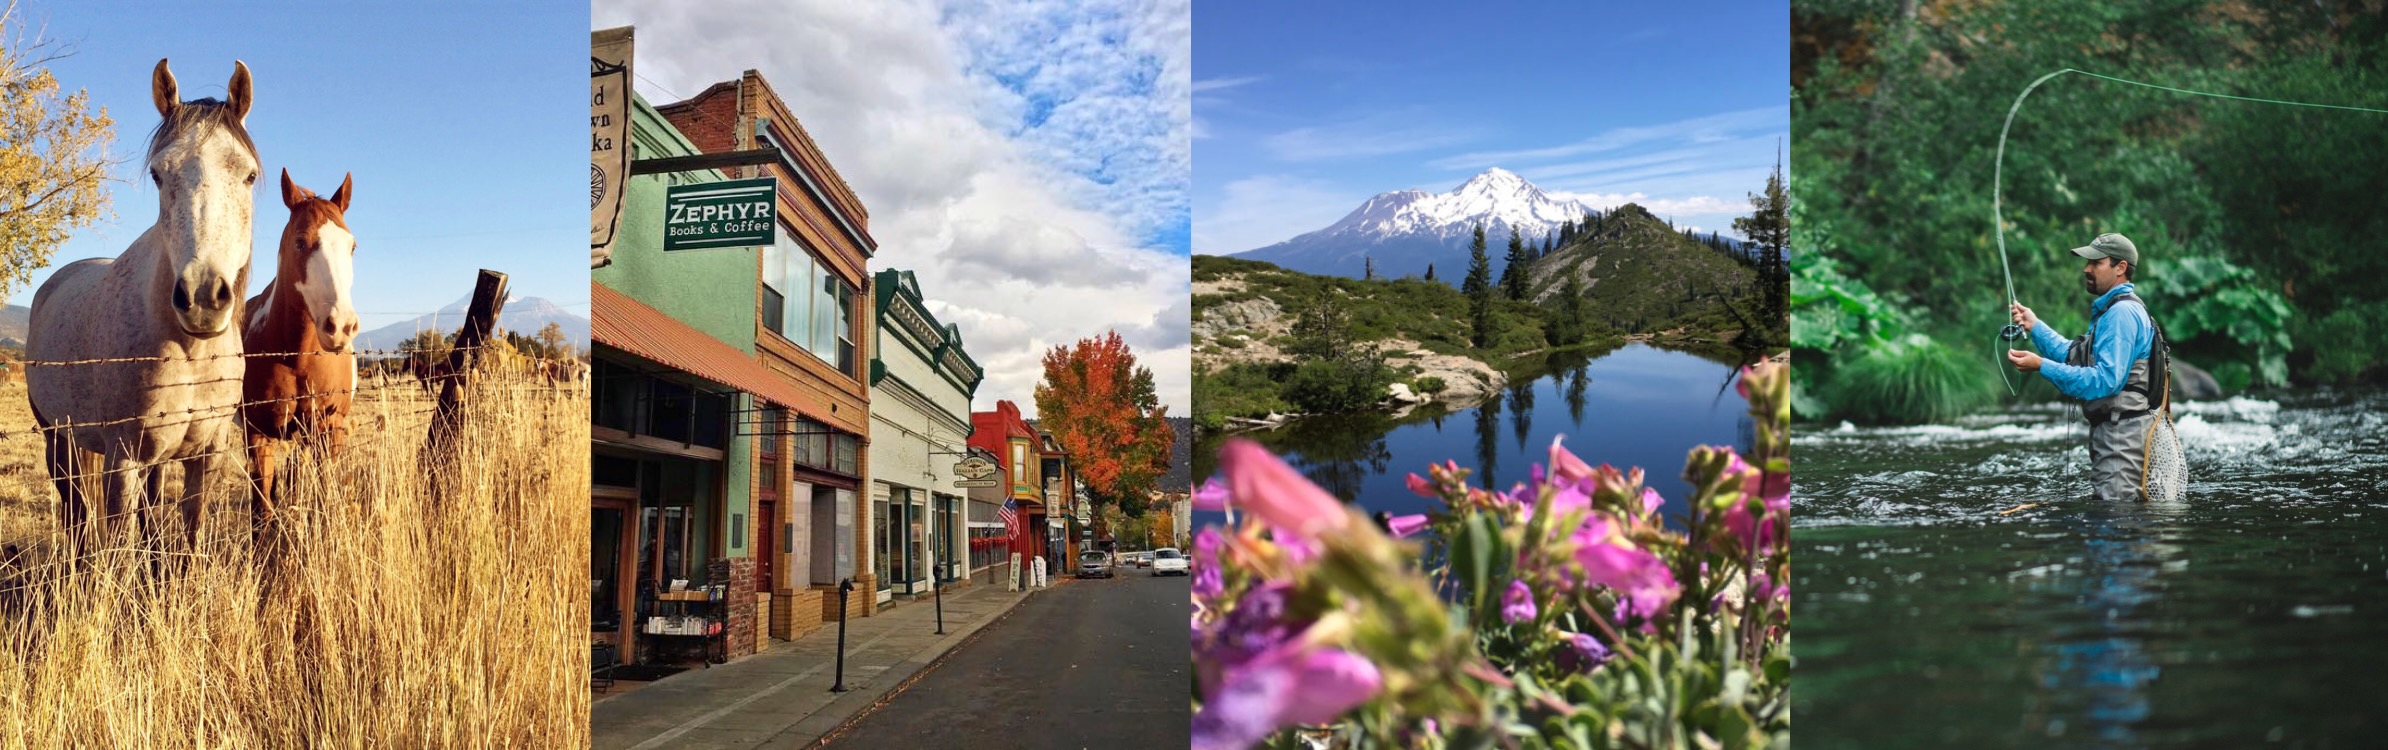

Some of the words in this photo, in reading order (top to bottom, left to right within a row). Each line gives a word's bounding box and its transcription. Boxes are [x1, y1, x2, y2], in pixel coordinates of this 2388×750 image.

[668, 201, 771, 224] ZEPHYR
[669, 225, 704, 236] Books
[710, 222, 719, 234] &
[724, 220, 770, 233] Coffee
[1011, 556, 1020, 585] OPEN
